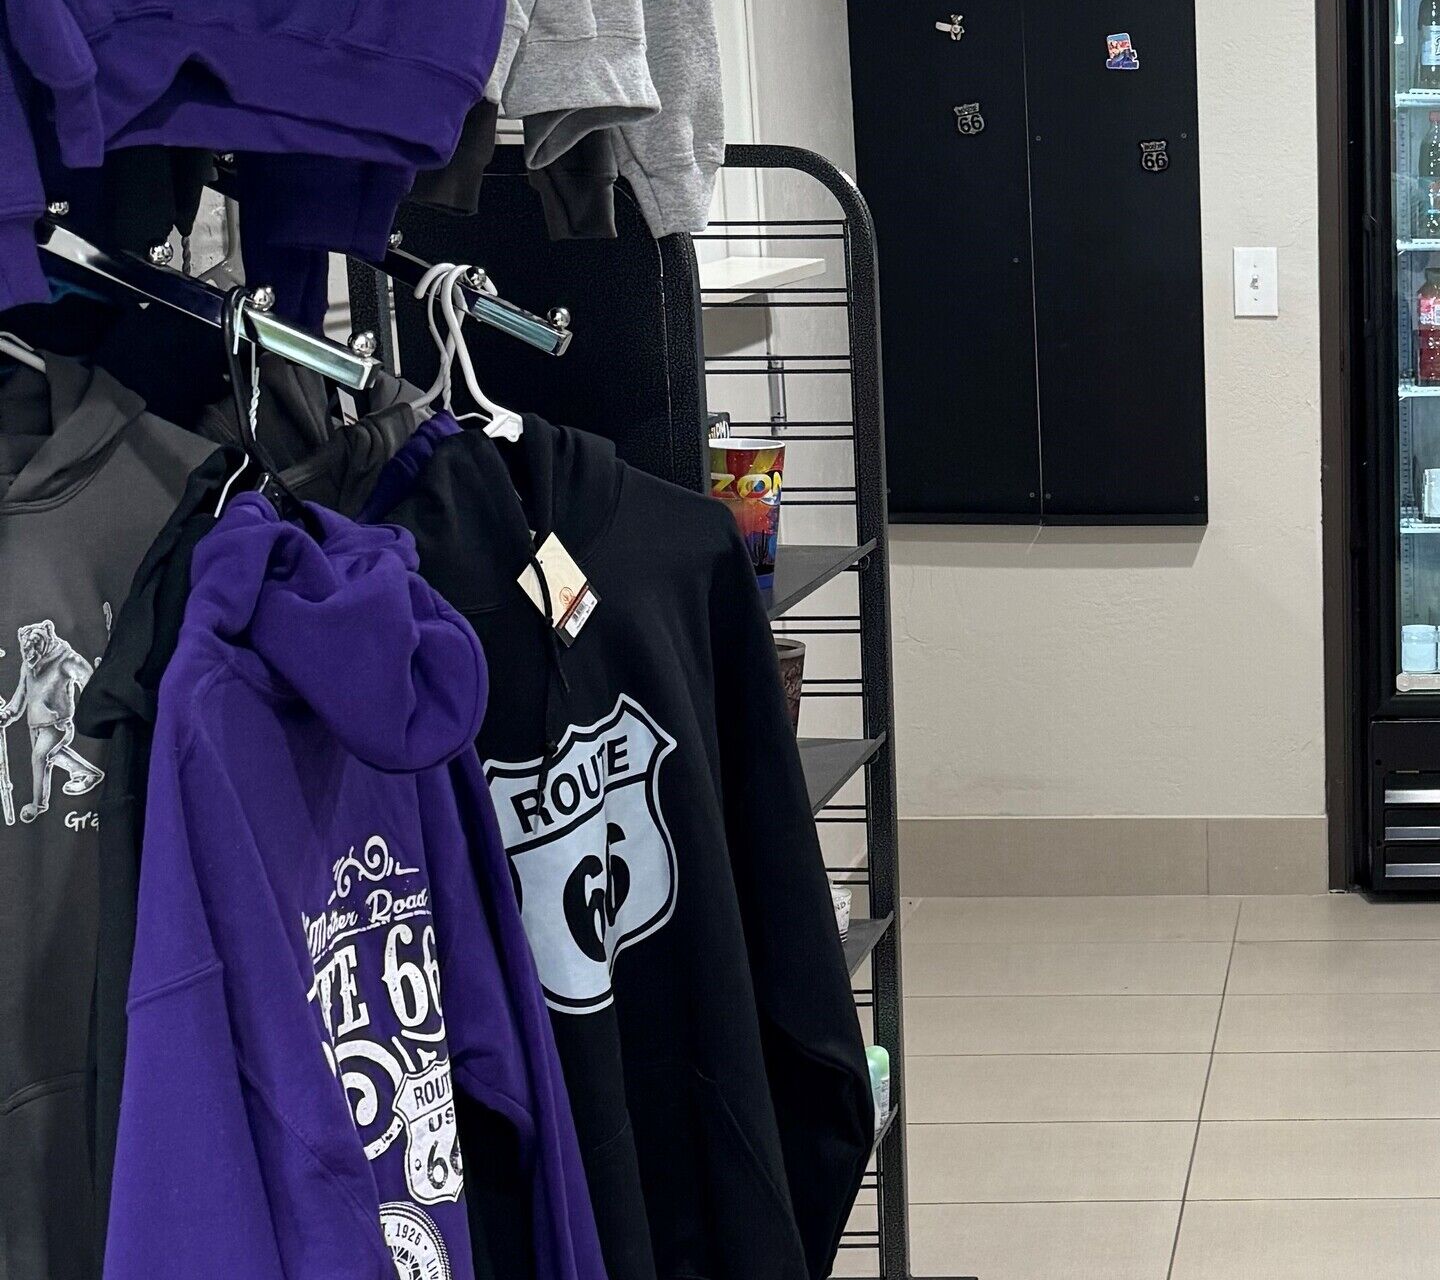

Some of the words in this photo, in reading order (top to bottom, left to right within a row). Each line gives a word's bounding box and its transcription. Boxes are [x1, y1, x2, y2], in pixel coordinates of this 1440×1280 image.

[960, 114, 982, 132] 66
[1144, 152, 1166, 169] 66
[510, 734, 630, 835] ROUE
[365, 888, 428, 923] Road
[413, 1071, 450, 1110] ROUT
[428, 1106, 455, 1133] US
[395, 1222, 422, 1246] 1926
